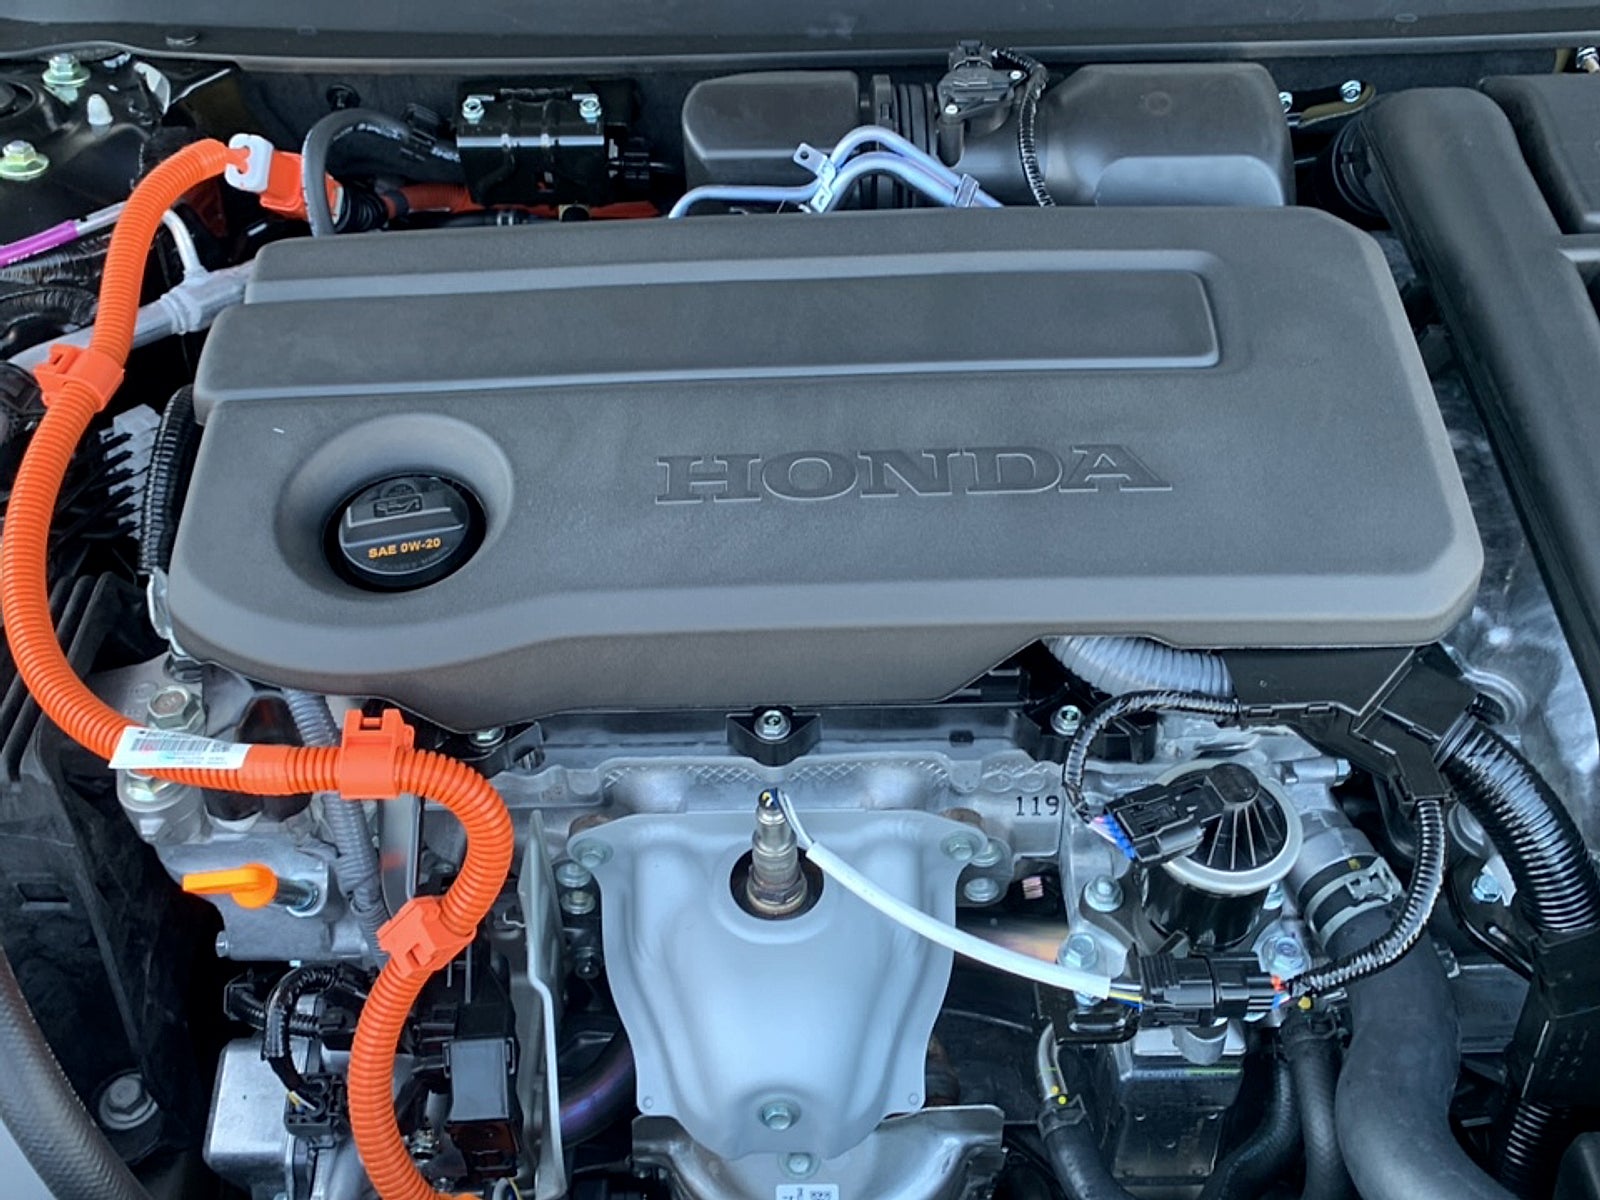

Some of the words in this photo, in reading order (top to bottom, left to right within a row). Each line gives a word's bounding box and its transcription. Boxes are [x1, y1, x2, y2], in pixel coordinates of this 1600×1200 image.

[655, 443, 1173, 504] HONDA
[368, 544, 397, 559] SAE
[400, 537, 442, 553] 0W-20
[1016, 795, 1060, 816] 119
